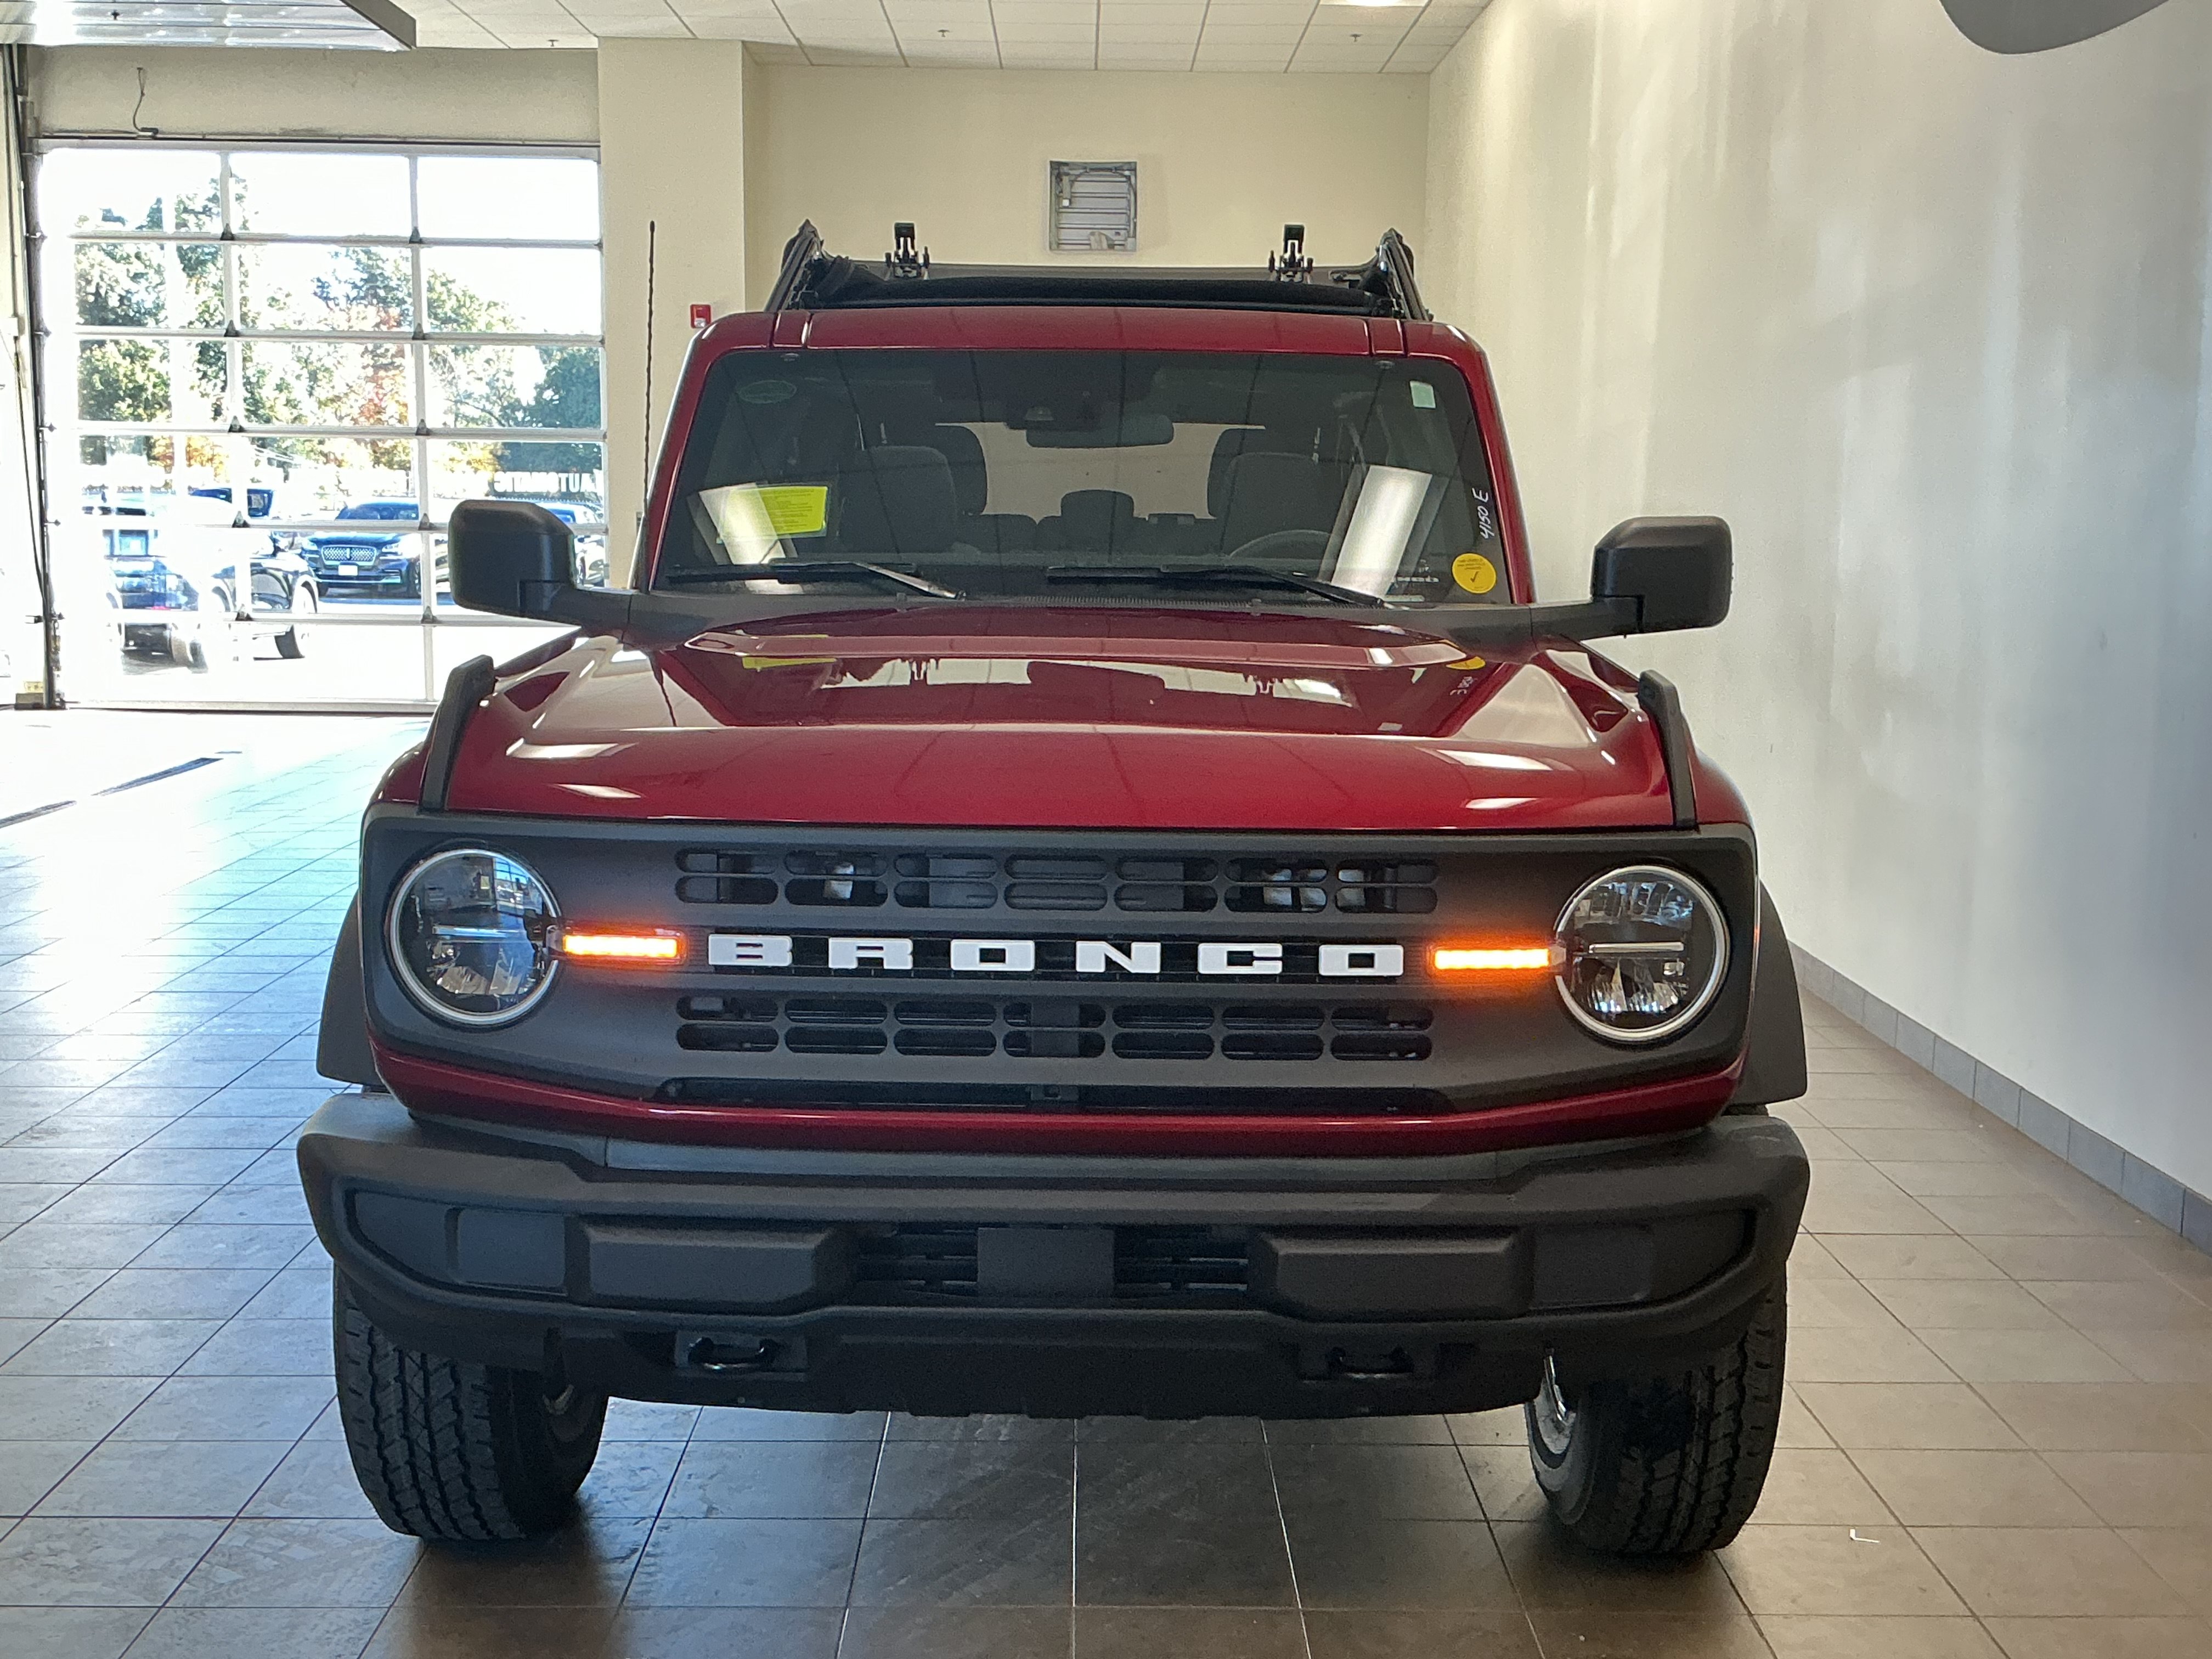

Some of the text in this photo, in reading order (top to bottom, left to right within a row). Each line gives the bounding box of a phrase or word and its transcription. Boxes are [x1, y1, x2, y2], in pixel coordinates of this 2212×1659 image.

[1471, 487, 1495, 539] 4150 E
[708, 934, 1404, 976] BRONCO
